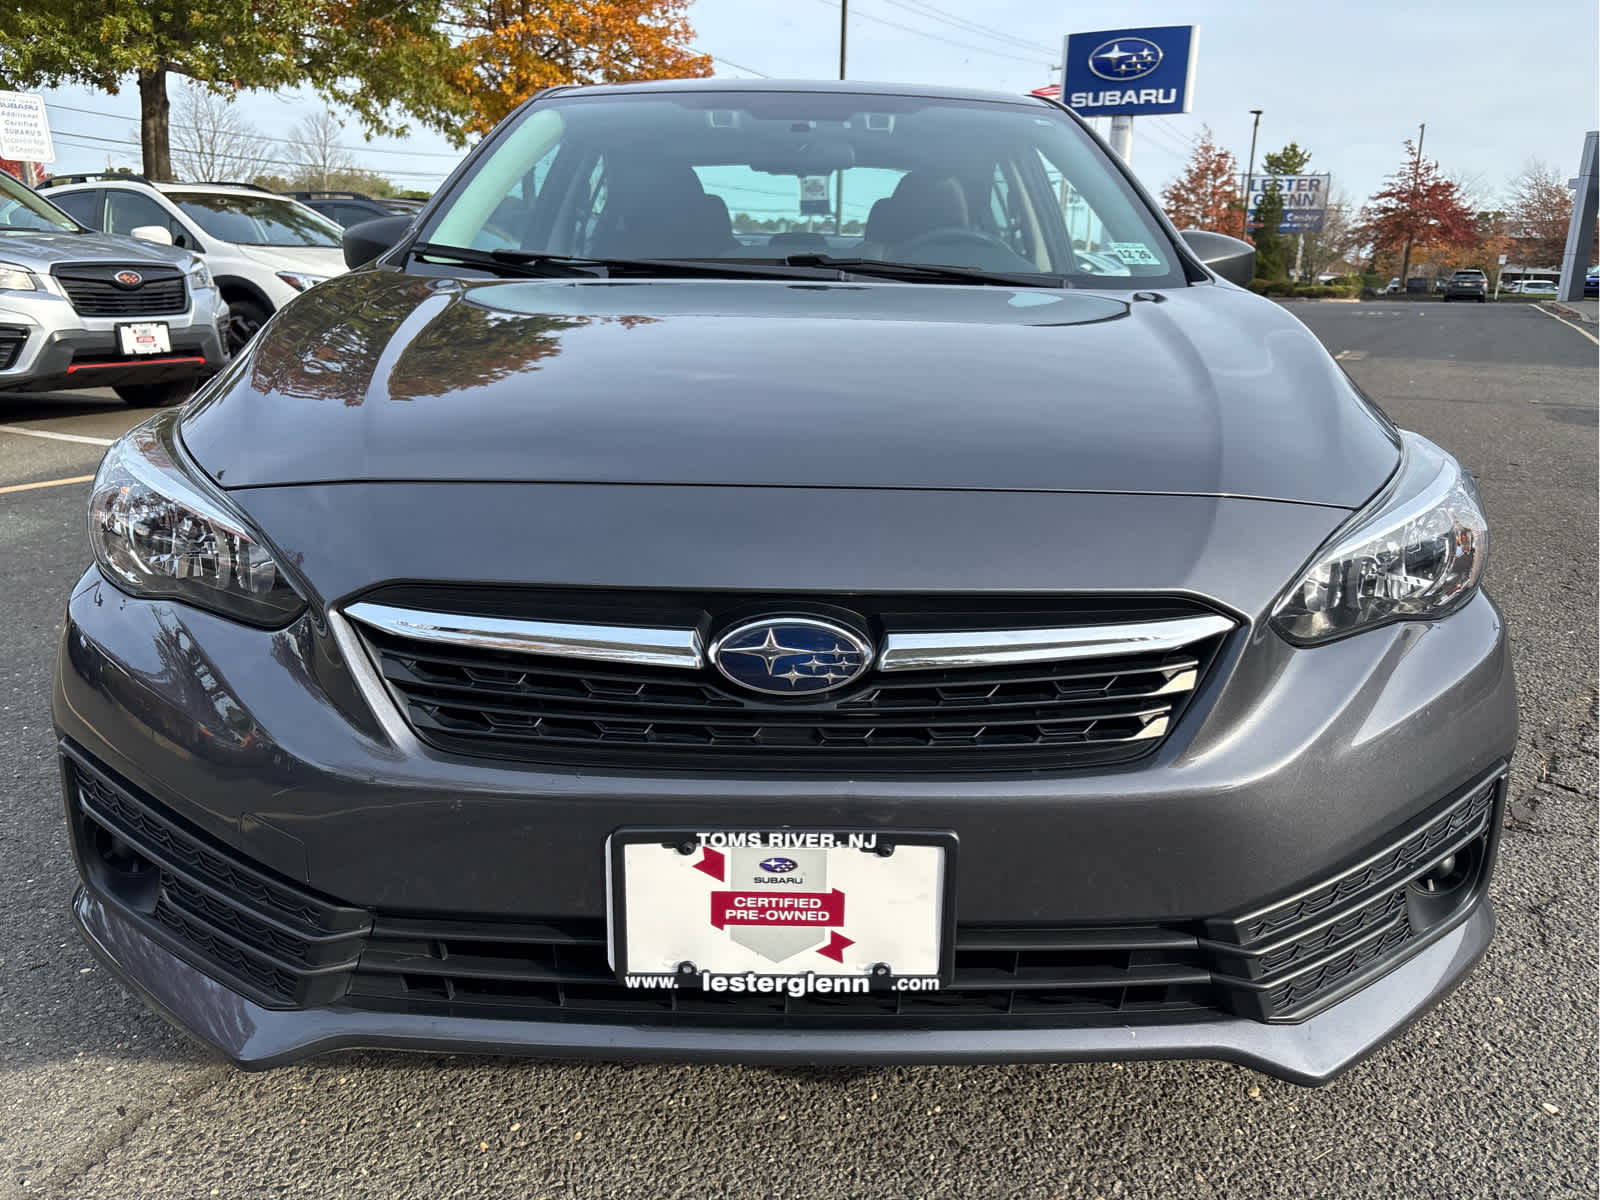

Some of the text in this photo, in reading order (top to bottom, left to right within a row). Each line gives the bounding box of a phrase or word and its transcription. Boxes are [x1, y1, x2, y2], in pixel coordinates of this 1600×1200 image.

[1070, 88, 1177, 108] SUBARU
[4, 120, 38, 128] Certified
[1250, 179, 1321, 192] LESTER
[696, 832, 761, 848] TOMS
[848, 834, 877, 849] NJ
[753, 876, 804, 885] SUBARU
[734, 896, 822, 909] CERTIFIED
[725, 909, 830, 921] PRE-OWNED
[625, 972, 940, 998] www. lesterglenn .com
